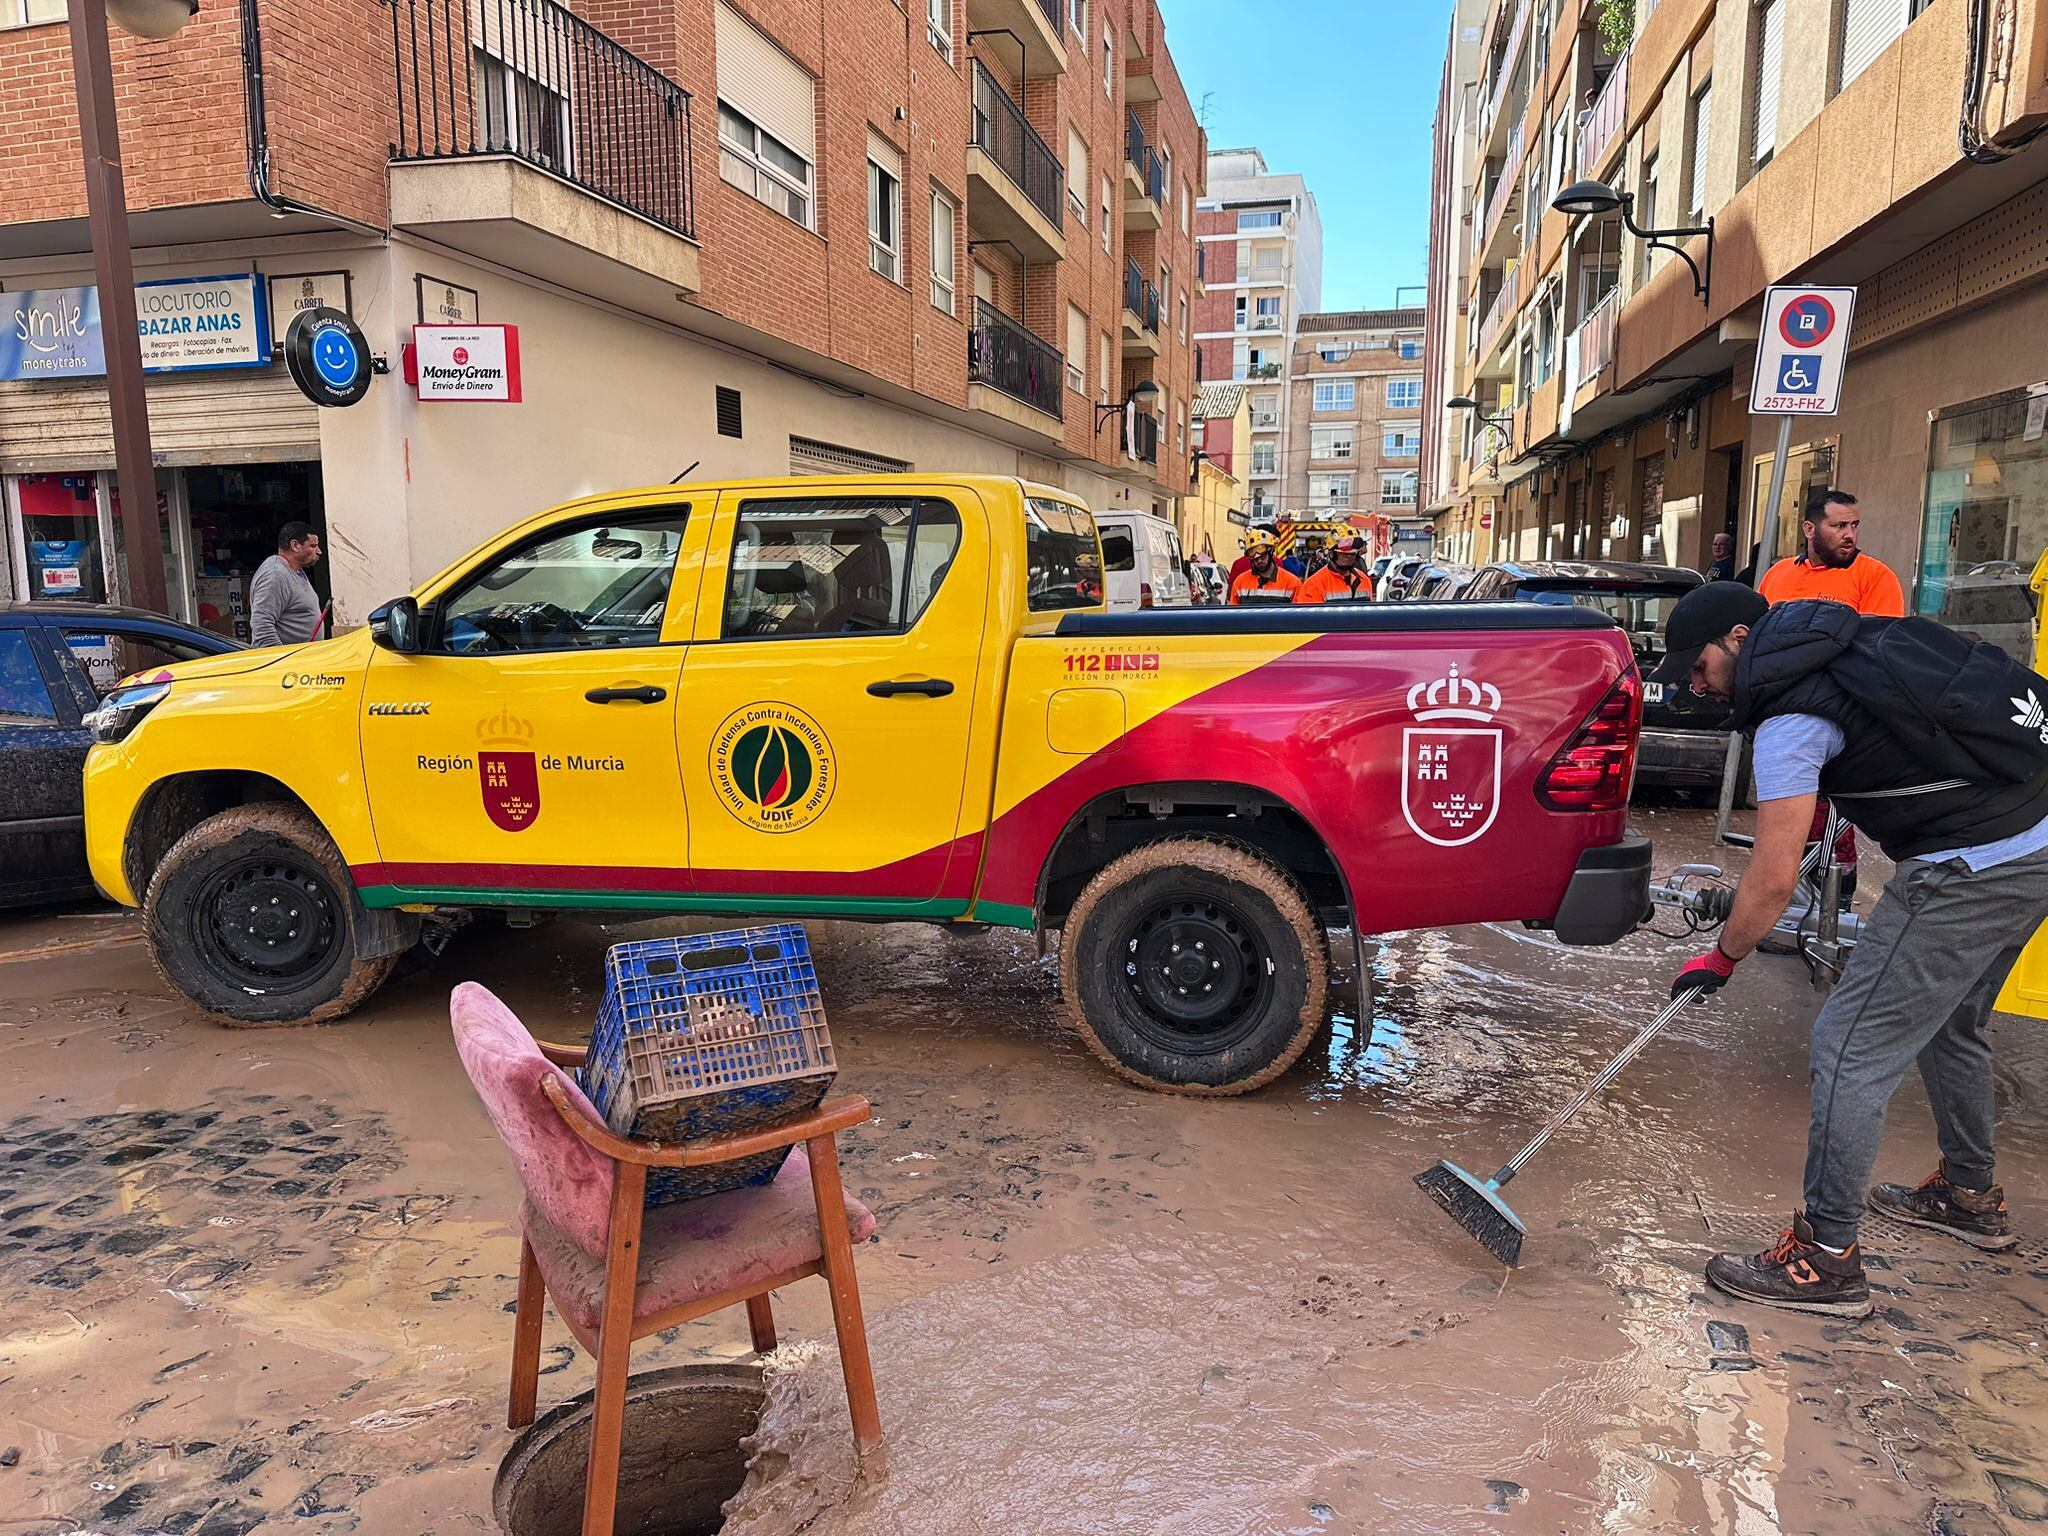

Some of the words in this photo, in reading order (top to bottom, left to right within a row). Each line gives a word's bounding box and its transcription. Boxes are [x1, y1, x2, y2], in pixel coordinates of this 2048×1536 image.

[141, 290, 232, 313] LOCUTORIO
[294, 297, 325, 310] CARRER
[14, 295, 87, 341] smile
[439, 304, 463, 320] CARRER
[138, 315, 192, 336] BAZAR
[196, 312, 242, 332] ANAS
[311, 317, 333, 332] Cuenta
[333, 319, 351, 335] smile
[1802, 317, 1812, 327] P
[150, 340, 179, 350] Recargas
[183, 337, 217, 348] Fotocopias
[221, 336, 232, 344] Fax
[150, 350, 159, 359] de
[160, 349, 179, 358] dinero
[183, 346, 215, 356] Liberación
[216, 345, 224, 354] de
[225, 344, 250, 354] móviles
[22, 356, 88, 371] moneytrans
[422, 366, 502, 381] MoneyGram
[324, 385, 355, 398] moneytrans
[432, 381, 454, 390] Envío
[455, 381, 465, 390] de
[466, 381, 494, 390] Dinero
[1763, 396, 1826, 410] 2573-FHZ
[1063, 655, 1101, 671] 112
[300, 673, 345, 686] Orthem
[1063, 673, 1098, 681] REGIÓN
[1123, 672, 1159, 680] MURCIA
[368, 701, 433, 716] HILUX
[746, 708, 782, 722] Contra
[717, 718, 747, 756] Defensa
[784, 711, 825, 756] Incendios
[417, 755, 473, 774] Región
[541, 754, 562, 770] de
[567, 755, 625, 771] Murcia
[716, 757, 726, 771] de
[717, 773, 745, 811] Unidad
[805, 757, 830, 812] Forestales
[747, 815, 772, 829] Región
[774, 822, 783, 830] de
[785, 815, 809, 829] Murcia
[761, 809, 794, 822] UDIF
